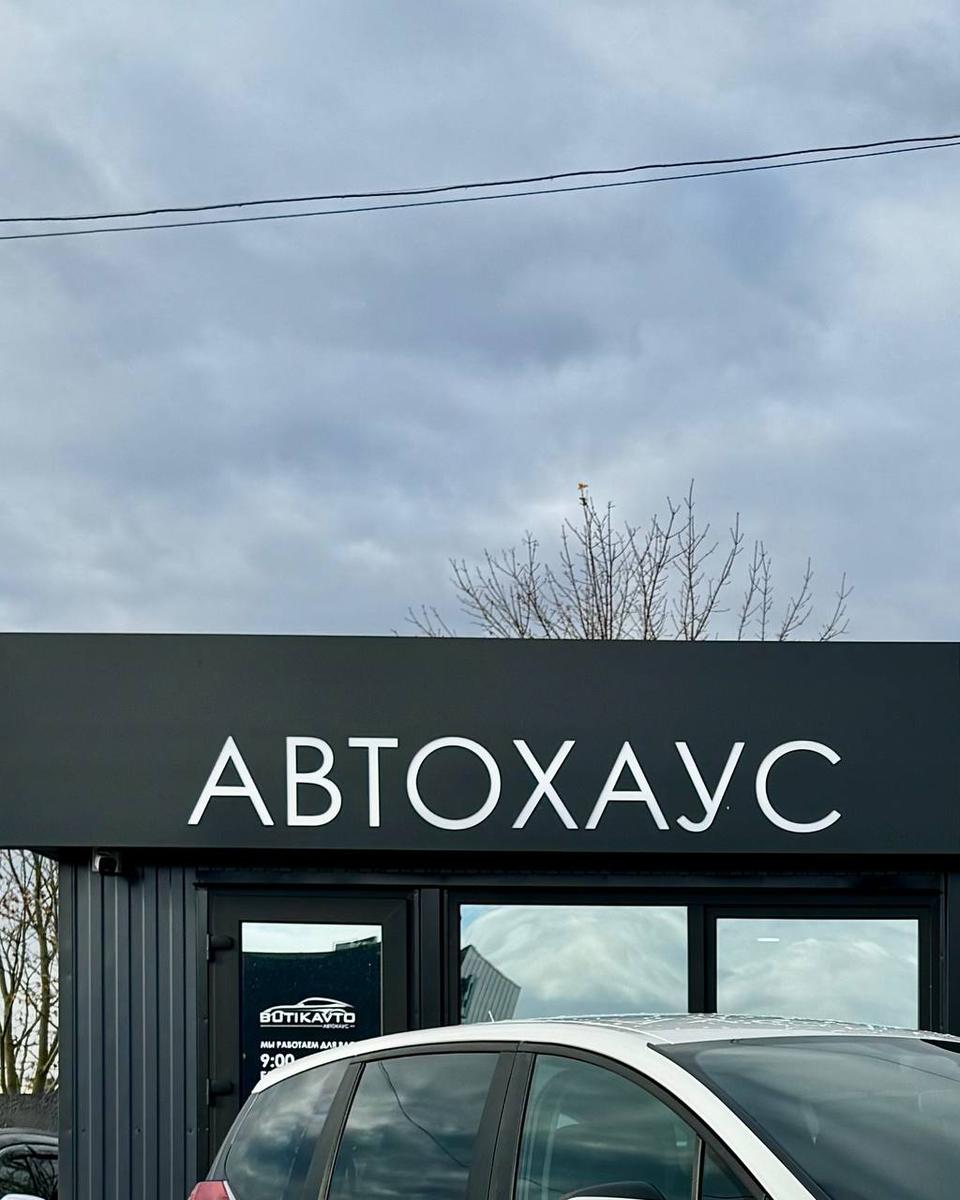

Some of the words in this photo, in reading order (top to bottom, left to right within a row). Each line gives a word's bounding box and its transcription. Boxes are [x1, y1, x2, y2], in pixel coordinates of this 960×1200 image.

[187, 735, 842, 834] АВТОХАУС
[260, 1011, 356, 1023] BUTIKAVTO
[260, 1041, 275, 1049] МЫ
[276, 1041, 319, 1049] РАБОТАЕМ
